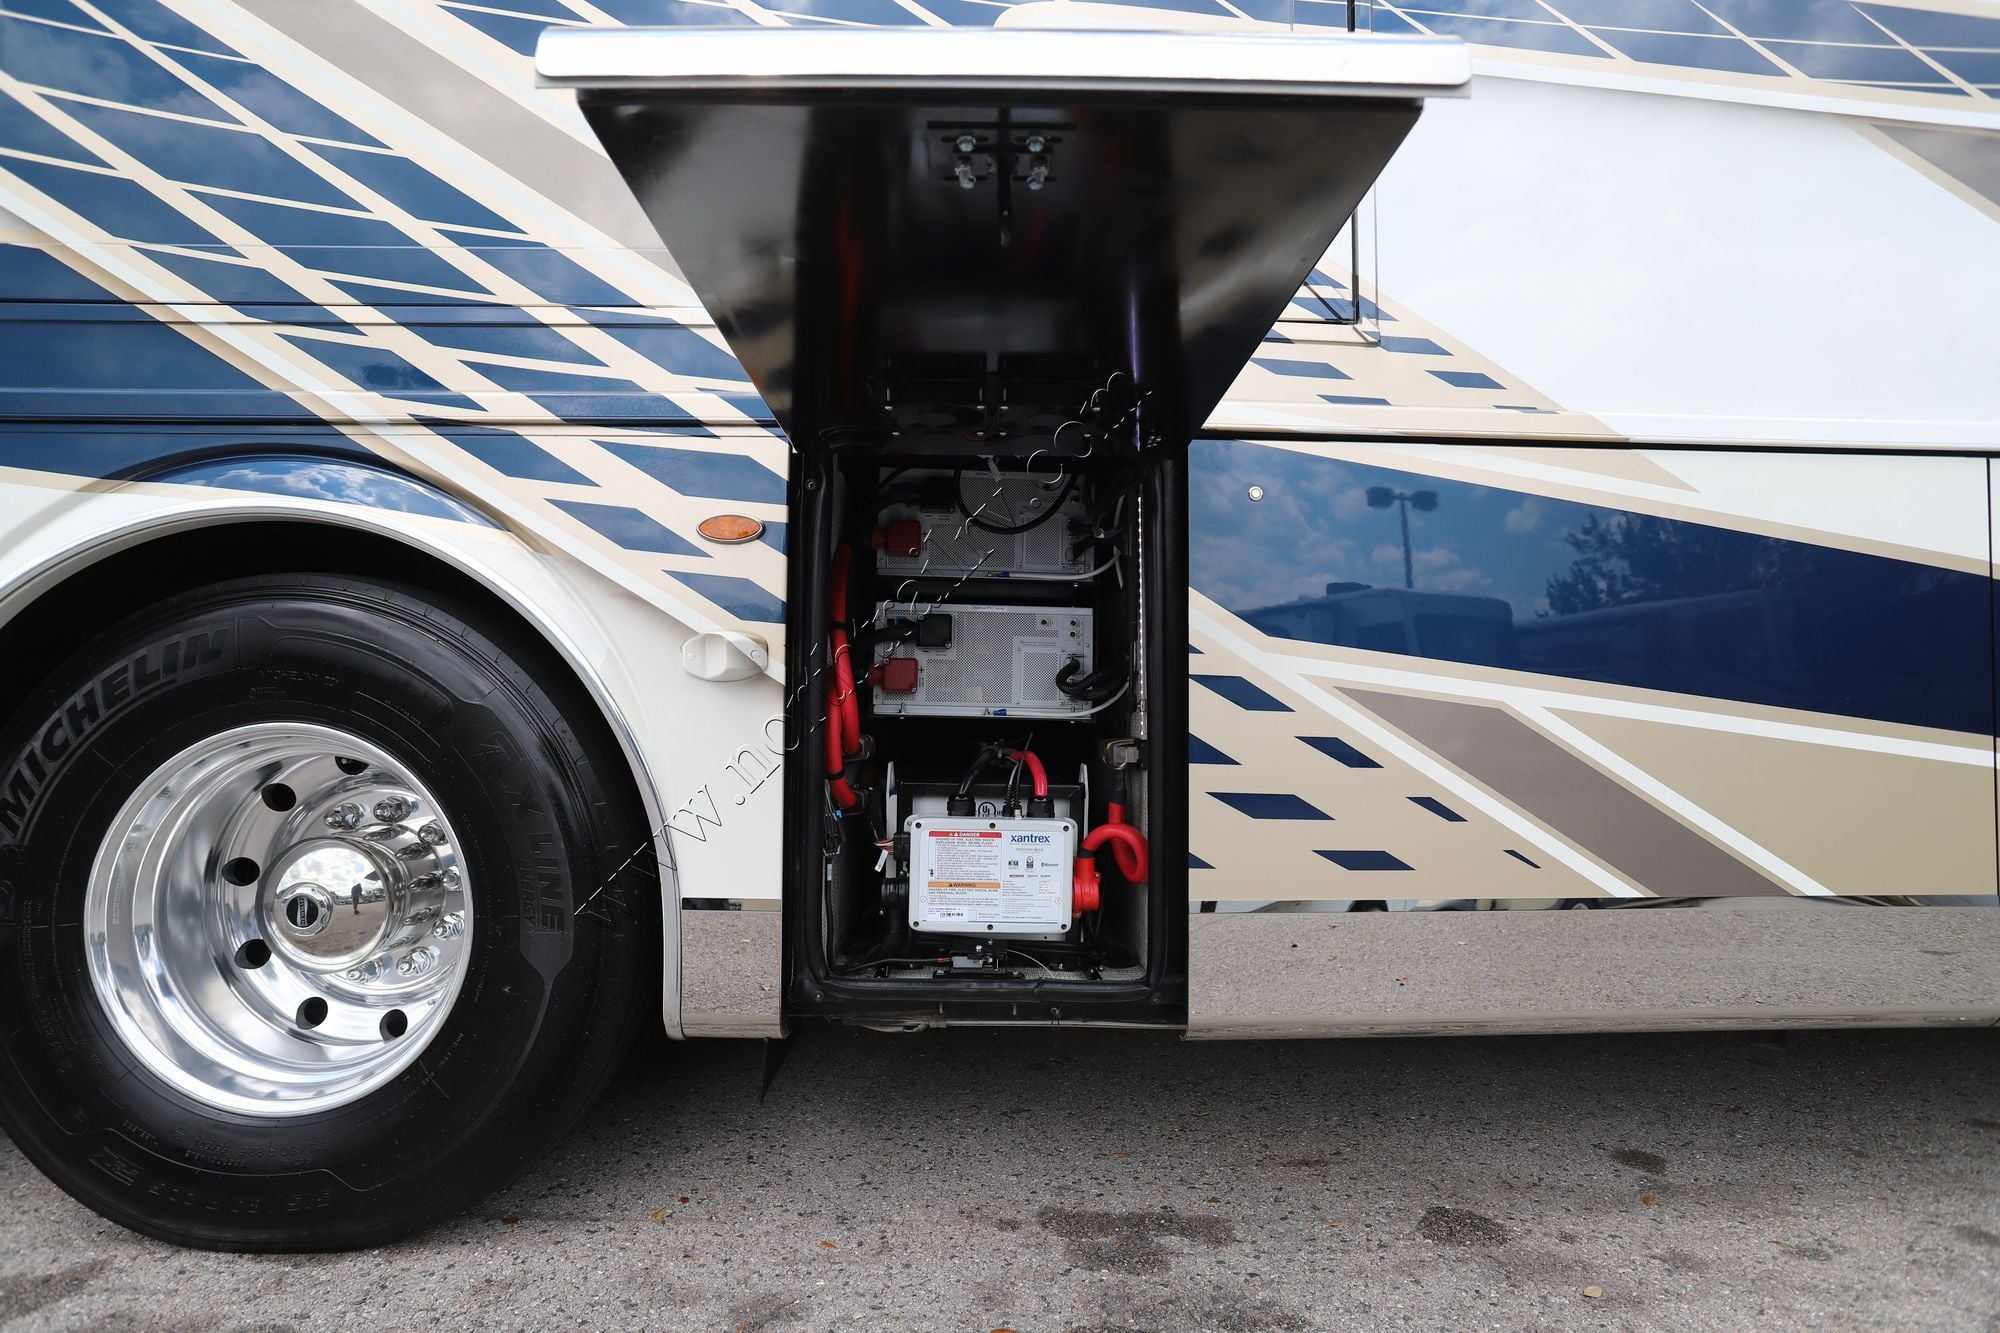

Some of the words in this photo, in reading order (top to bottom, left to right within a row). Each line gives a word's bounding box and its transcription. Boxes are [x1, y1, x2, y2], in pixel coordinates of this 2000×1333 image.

[0, 628, 229, 838] MICHELIN
[527, 832, 566, 933] LINE
[1010, 834, 1050, 843] xantrex
